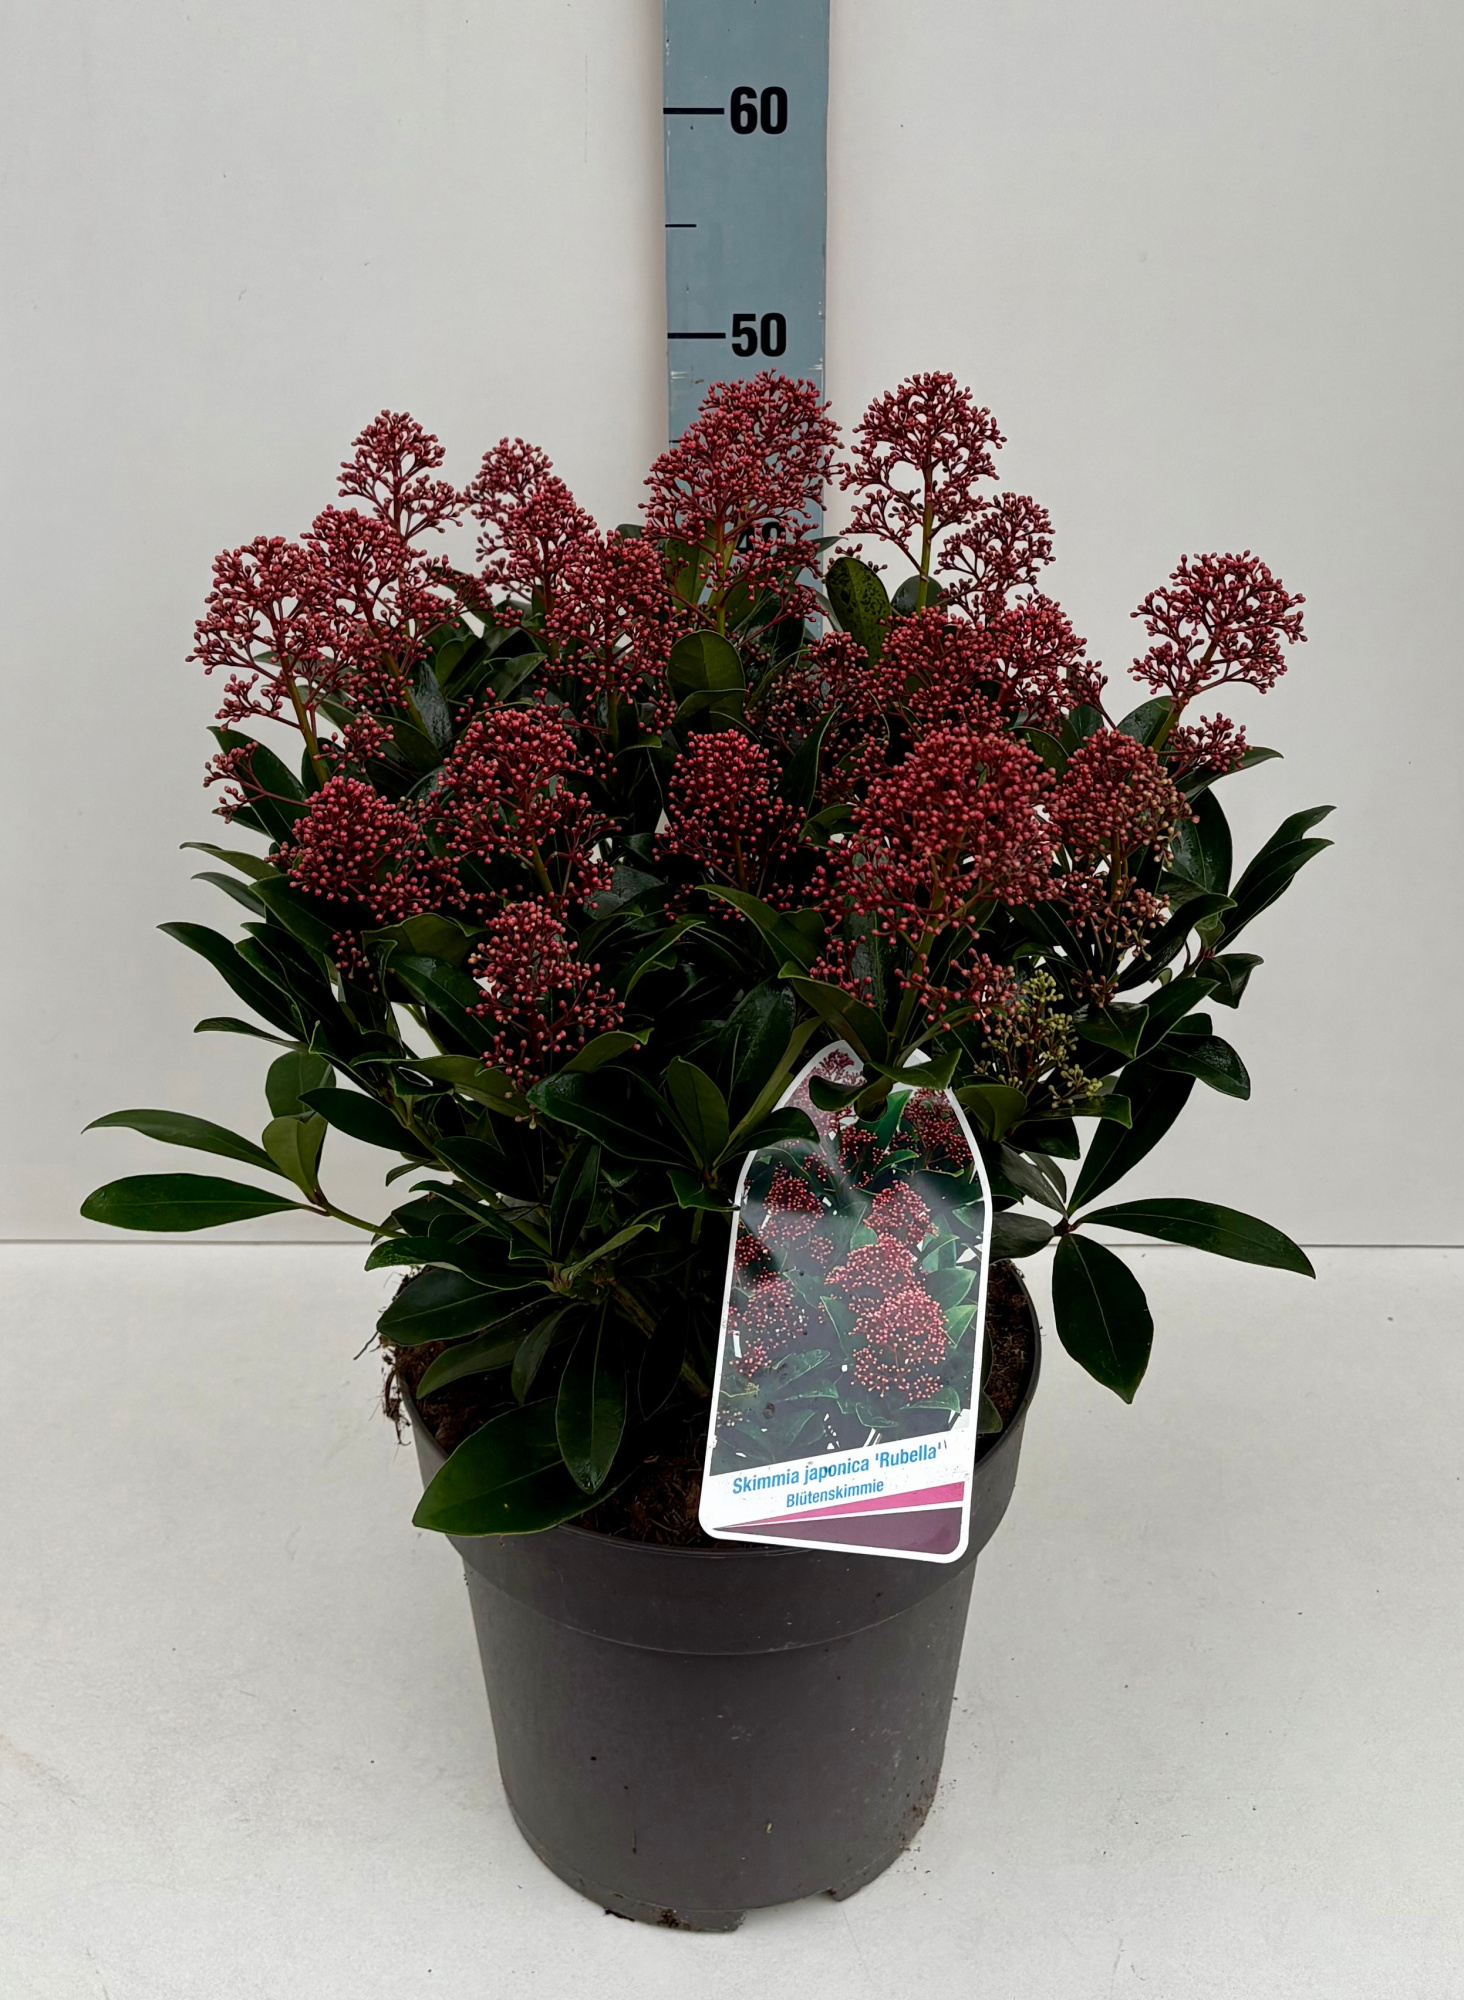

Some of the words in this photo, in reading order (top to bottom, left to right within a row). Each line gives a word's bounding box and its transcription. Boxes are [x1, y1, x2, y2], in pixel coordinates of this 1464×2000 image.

[730, 86, 788, 134] 60
[731, 312, 786, 357] 50
[732, 1469, 800, 1495] Skimmia
[803, 1458, 869, 1484] japonica
[875, 1442, 942, 1468] 'Rubella'
[786, 1479, 884, 1508] Blütenskimmie
